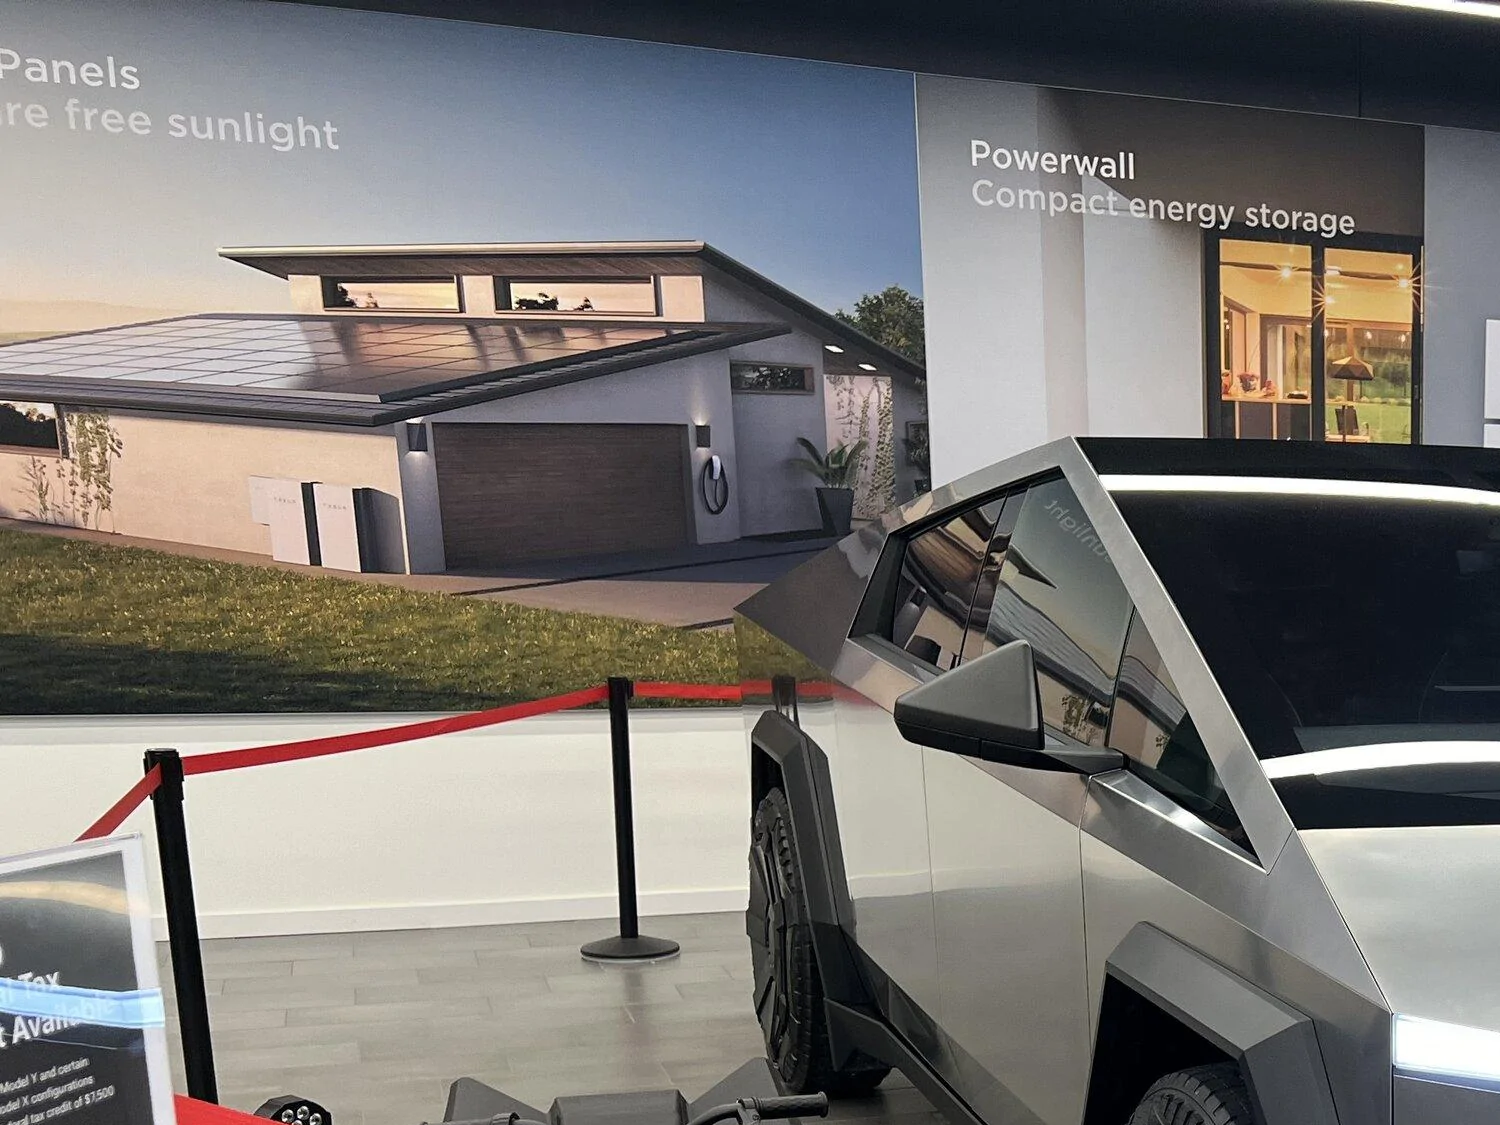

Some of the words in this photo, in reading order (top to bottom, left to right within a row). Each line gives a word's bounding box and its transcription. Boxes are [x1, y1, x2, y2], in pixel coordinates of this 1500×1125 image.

[0, 47, 140, 90] Panels
[0, 101, 49, 127] re
[64, 98, 151, 134] free
[168, 112, 339, 151] sunlight
[971, 139, 1135, 180] Powerwall
[972, 179, 1119, 217] Compact
[1129, 197, 1235, 230] energy
[1245, 203, 1356, 239] storage
[30, 1071, 38, 1084] Y
[39, 1065, 57, 1082] and
[57, 1057, 91, 1076] certain
[0, 1098, 20, 1115] odel
[22, 1095, 29, 1107] X
[30, 1075, 95, 1104] configurations
[30, 1111, 46, 1124] tax
[45, 1100, 73, 1119] credit
[73, 1096, 83, 1109] of
